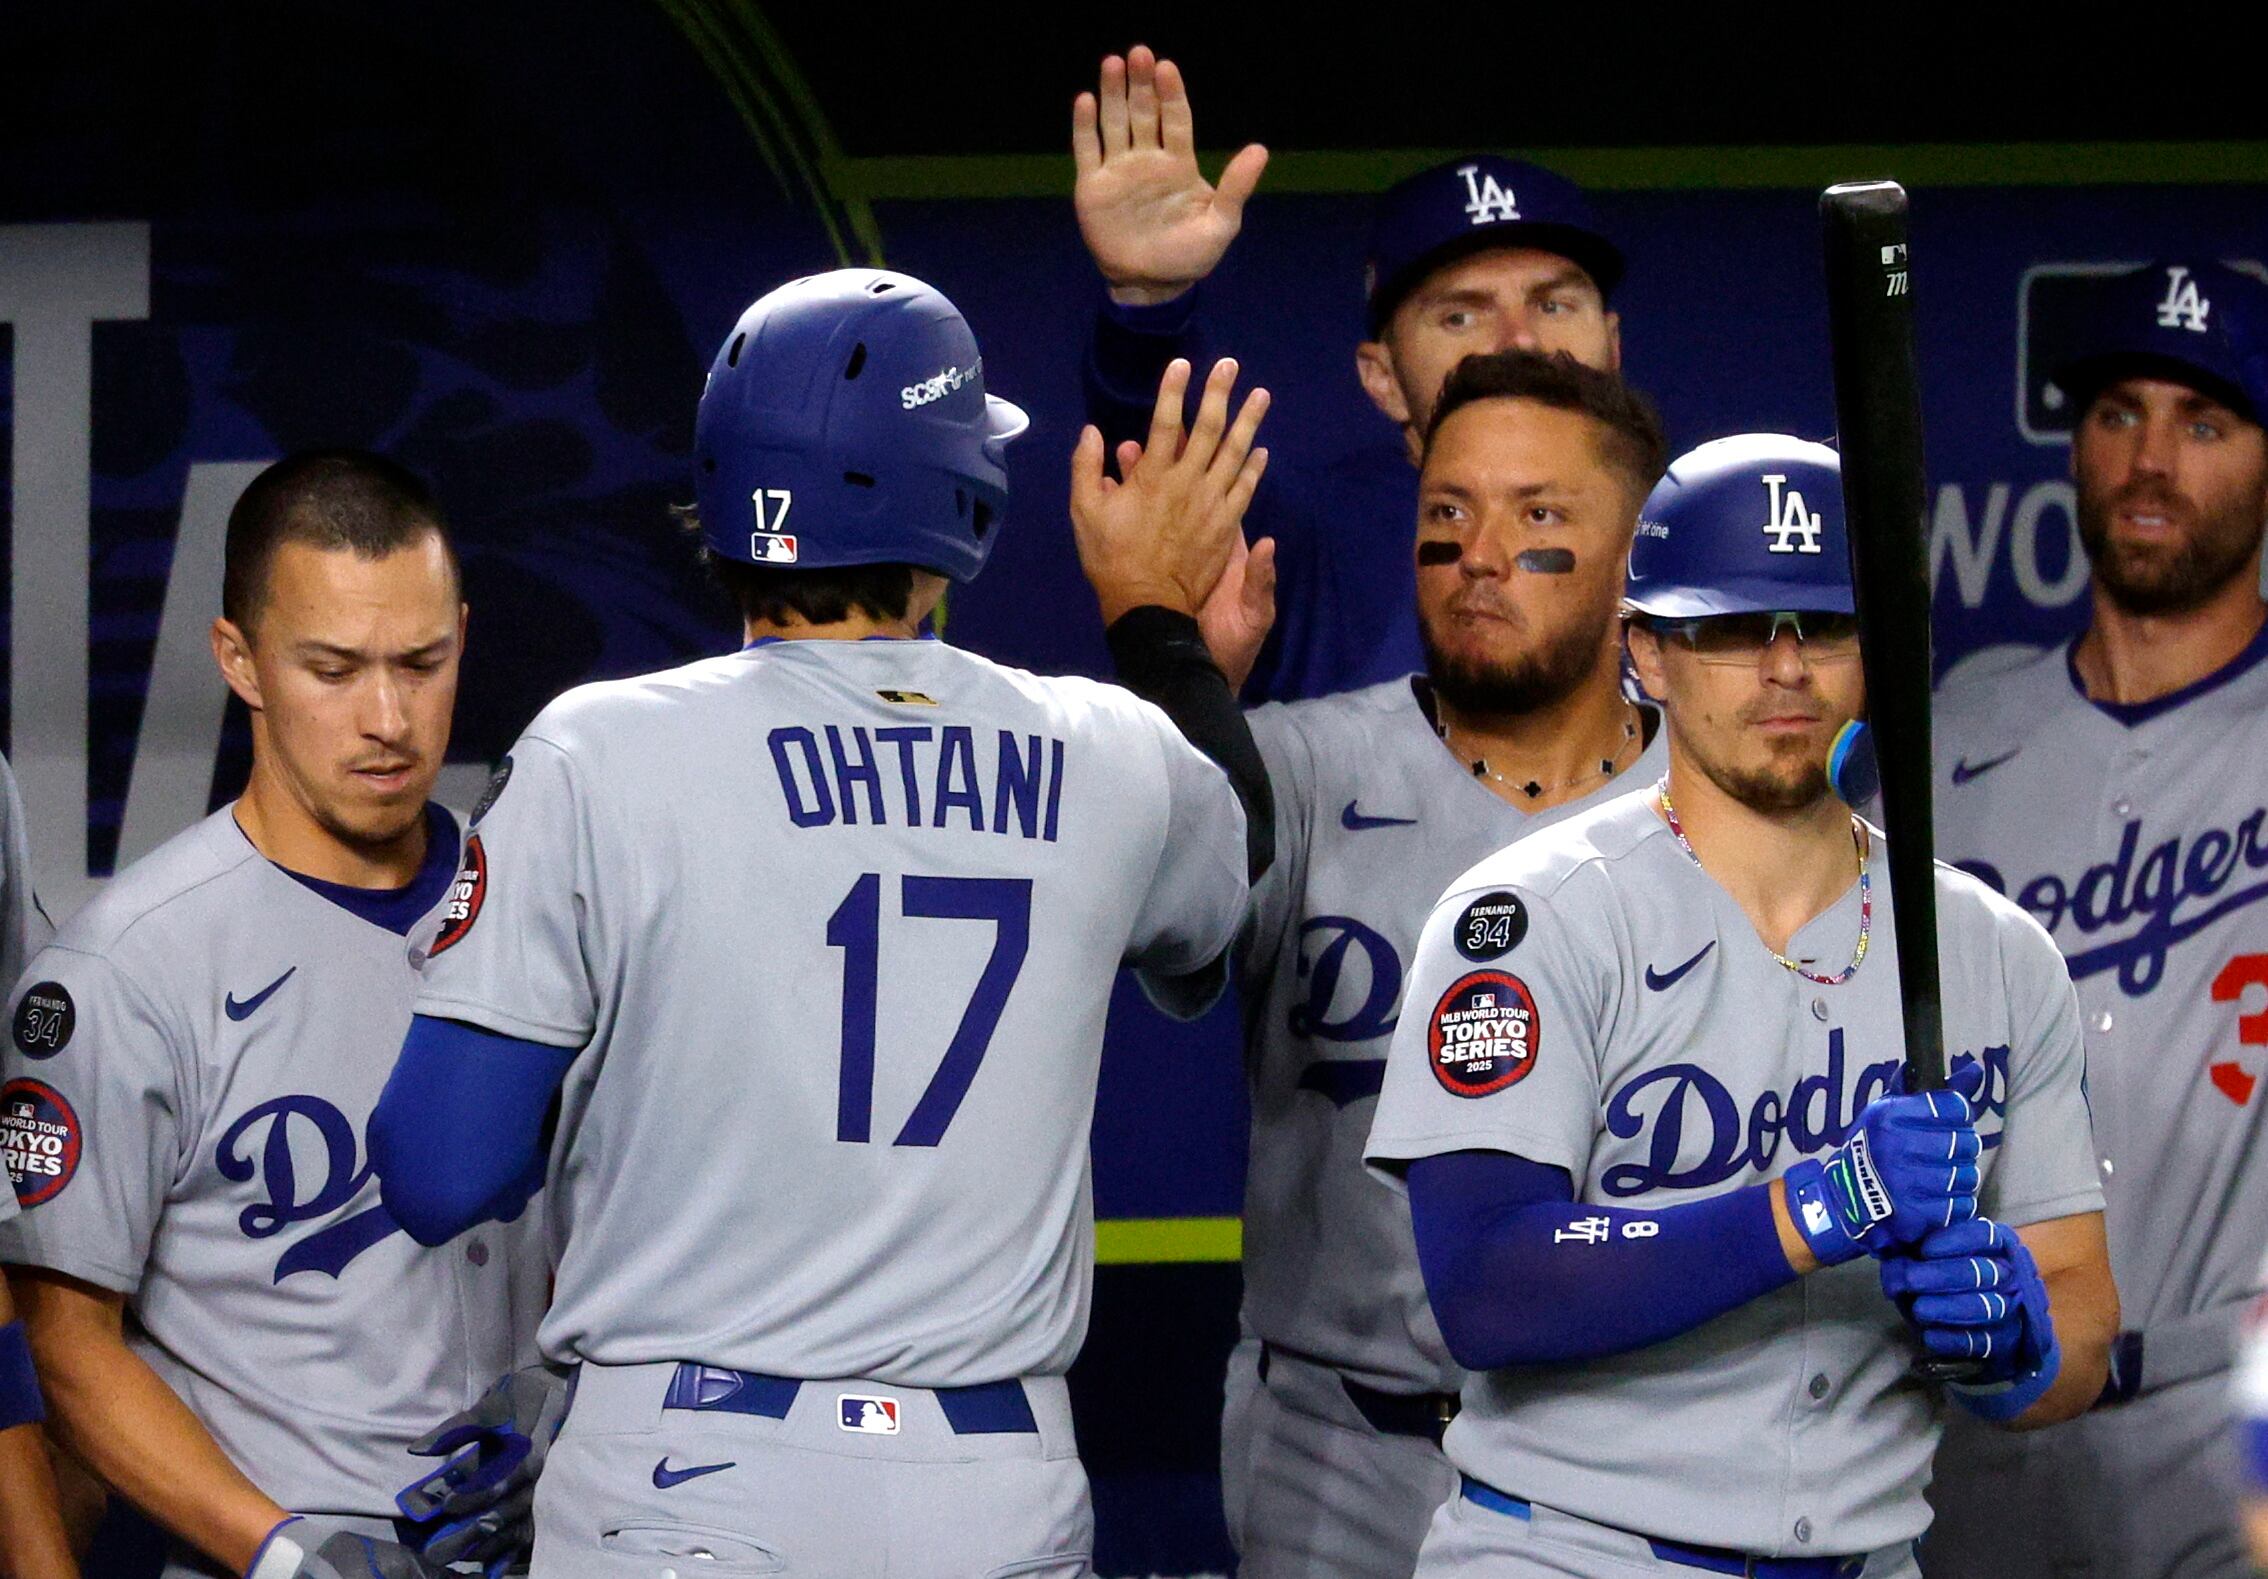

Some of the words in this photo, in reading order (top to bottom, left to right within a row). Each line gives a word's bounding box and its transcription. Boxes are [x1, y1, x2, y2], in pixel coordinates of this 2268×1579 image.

[1456, 164, 1522, 225] LA
[2156, 266, 2211, 333] LA
[752, 488, 792, 531] 17
[1761, 474, 1821, 553] LA
[767, 725, 1064, 842] OHTANI
[1470, 905, 1516, 917] FERNANDO
[1467, 916, 1510, 949] 34
[826, 873, 1033, 1147] 17
[1440, 1012, 1461, 1024] MLB
[1462, 1008, 1499, 1021] WORLD
[1500, 1008, 1530, 1021] TOUR
[23, 1008, 61, 1047] 34
[1442, 1019, 1526, 1044] TOKYO
[1440, 1038, 1527, 1063] SERIES
[1466, 1060, 1492, 1073] 2025
[0, 1128, 63, 1156] OKYO
[37, 1121, 68, 1137] TOUR
[5, 1148, 62, 1176] RIES
[9, 1171, 24, 1185] 25
[1621, 1221, 1659, 1239] 8
